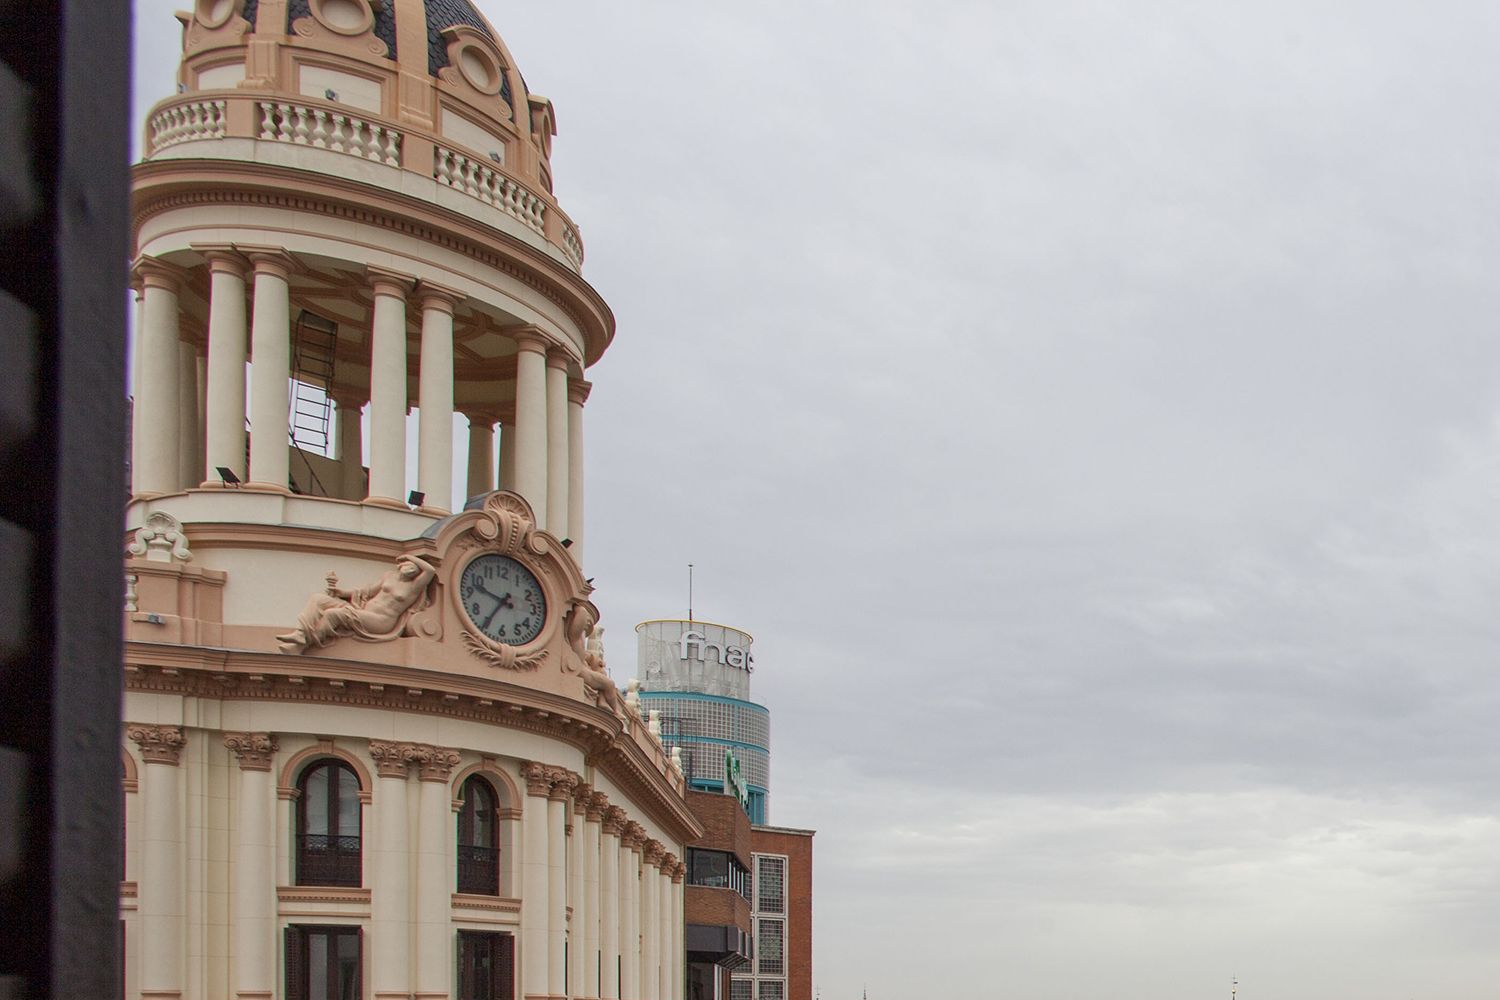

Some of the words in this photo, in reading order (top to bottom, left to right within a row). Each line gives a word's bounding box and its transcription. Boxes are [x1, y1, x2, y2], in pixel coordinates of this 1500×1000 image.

[483, 565, 493, 580] 11
[496, 565, 509, 581] 12
[515, 575, 520, 587] 1
[466, 586, 474, 599] 9
[524, 589, 533, 602] 2
[472, 604, 480, 615] 8
[529, 604, 537, 616] 3
[513, 624, 522, 636] 5
[521, 617, 531, 630] 4
[498, 624, 506, 637] 6
[678, 630, 755, 674] fnac
